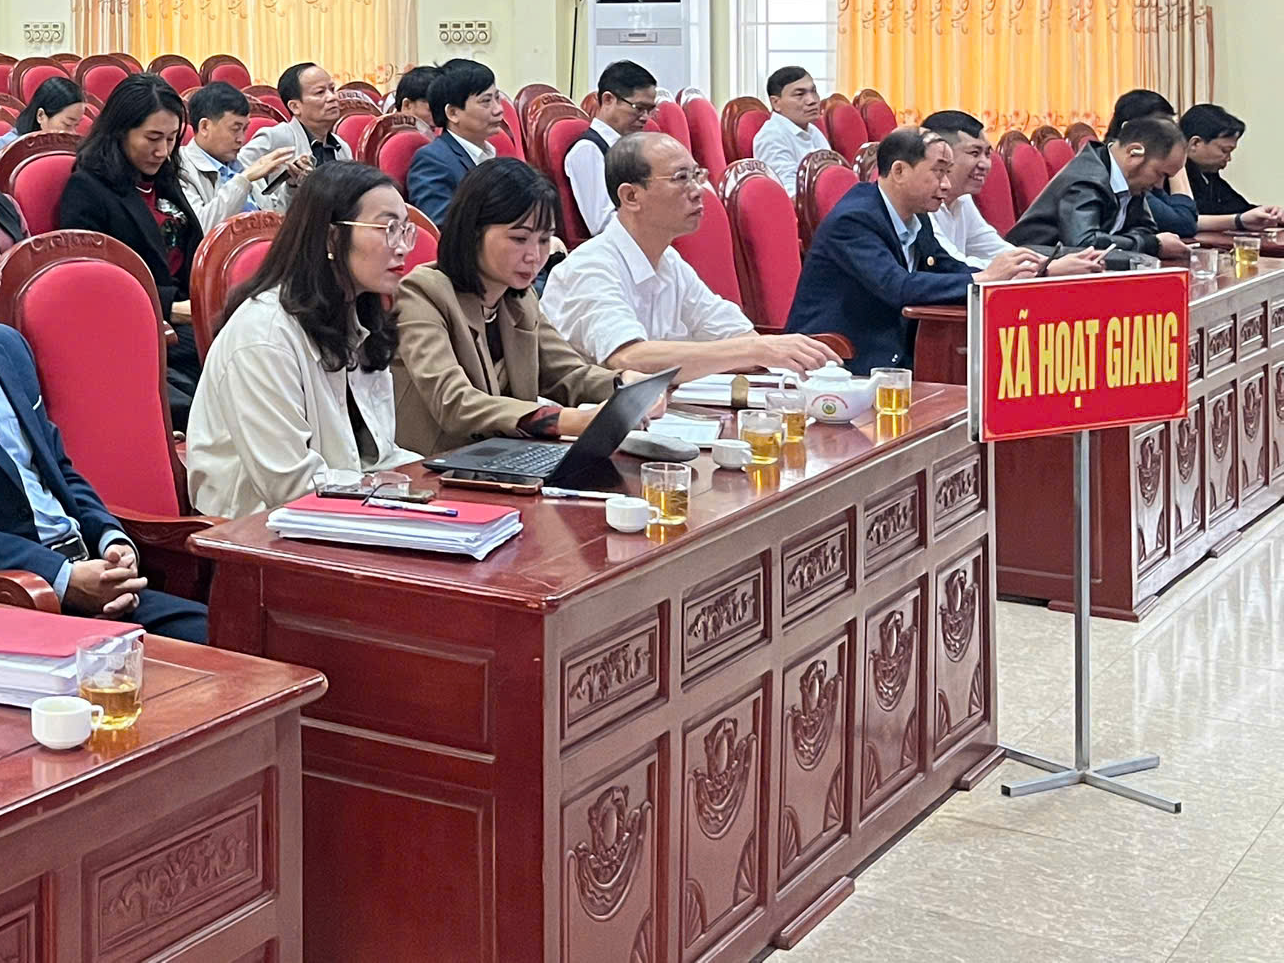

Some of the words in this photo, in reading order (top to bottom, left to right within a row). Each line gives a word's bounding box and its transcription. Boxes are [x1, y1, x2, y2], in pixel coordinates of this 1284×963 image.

[998, 309, 1032, 400] XÃ
[1038, 319, 1100, 409] HOẠT
[1106, 312, 1178, 389] GIANG
